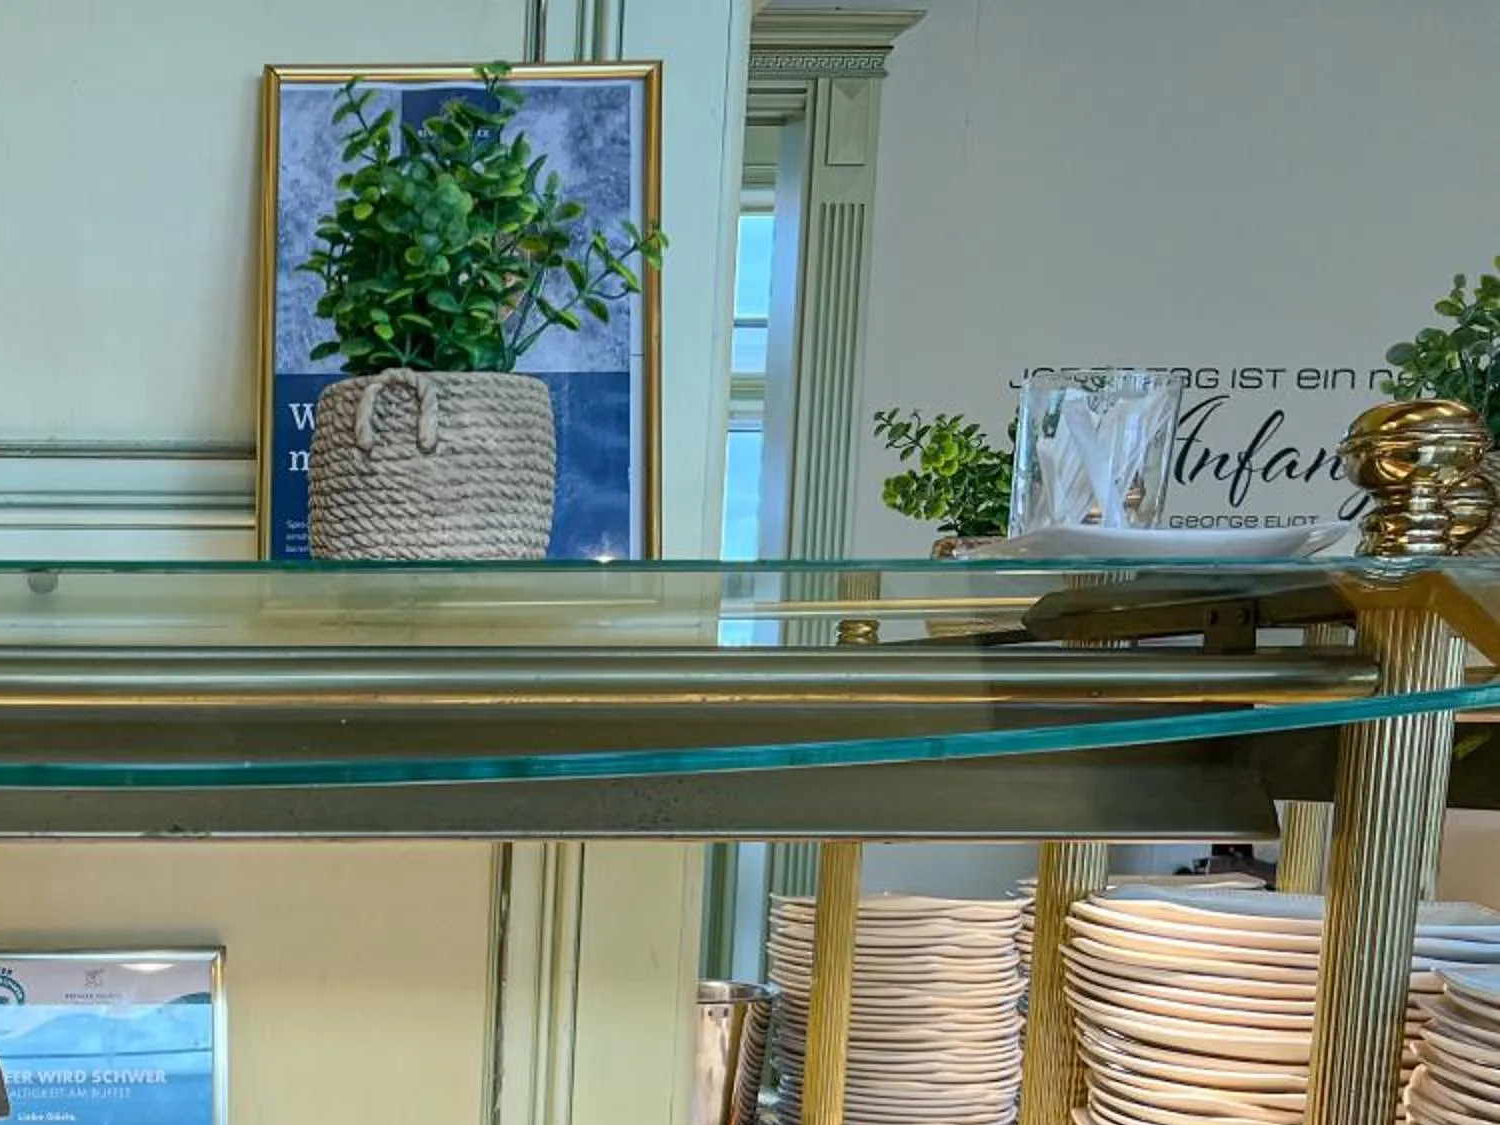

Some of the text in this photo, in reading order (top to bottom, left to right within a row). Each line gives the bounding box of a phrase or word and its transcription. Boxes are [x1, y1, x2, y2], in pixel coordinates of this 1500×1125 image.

[1231, 368, 1286, 389] IST
[1173, 395, 1376, 521] Anfan
[4, 1070, 35, 1085] EER
[37, 1070, 87, 1085] WIRD
[91, 1069, 167, 1084] SCHWER
